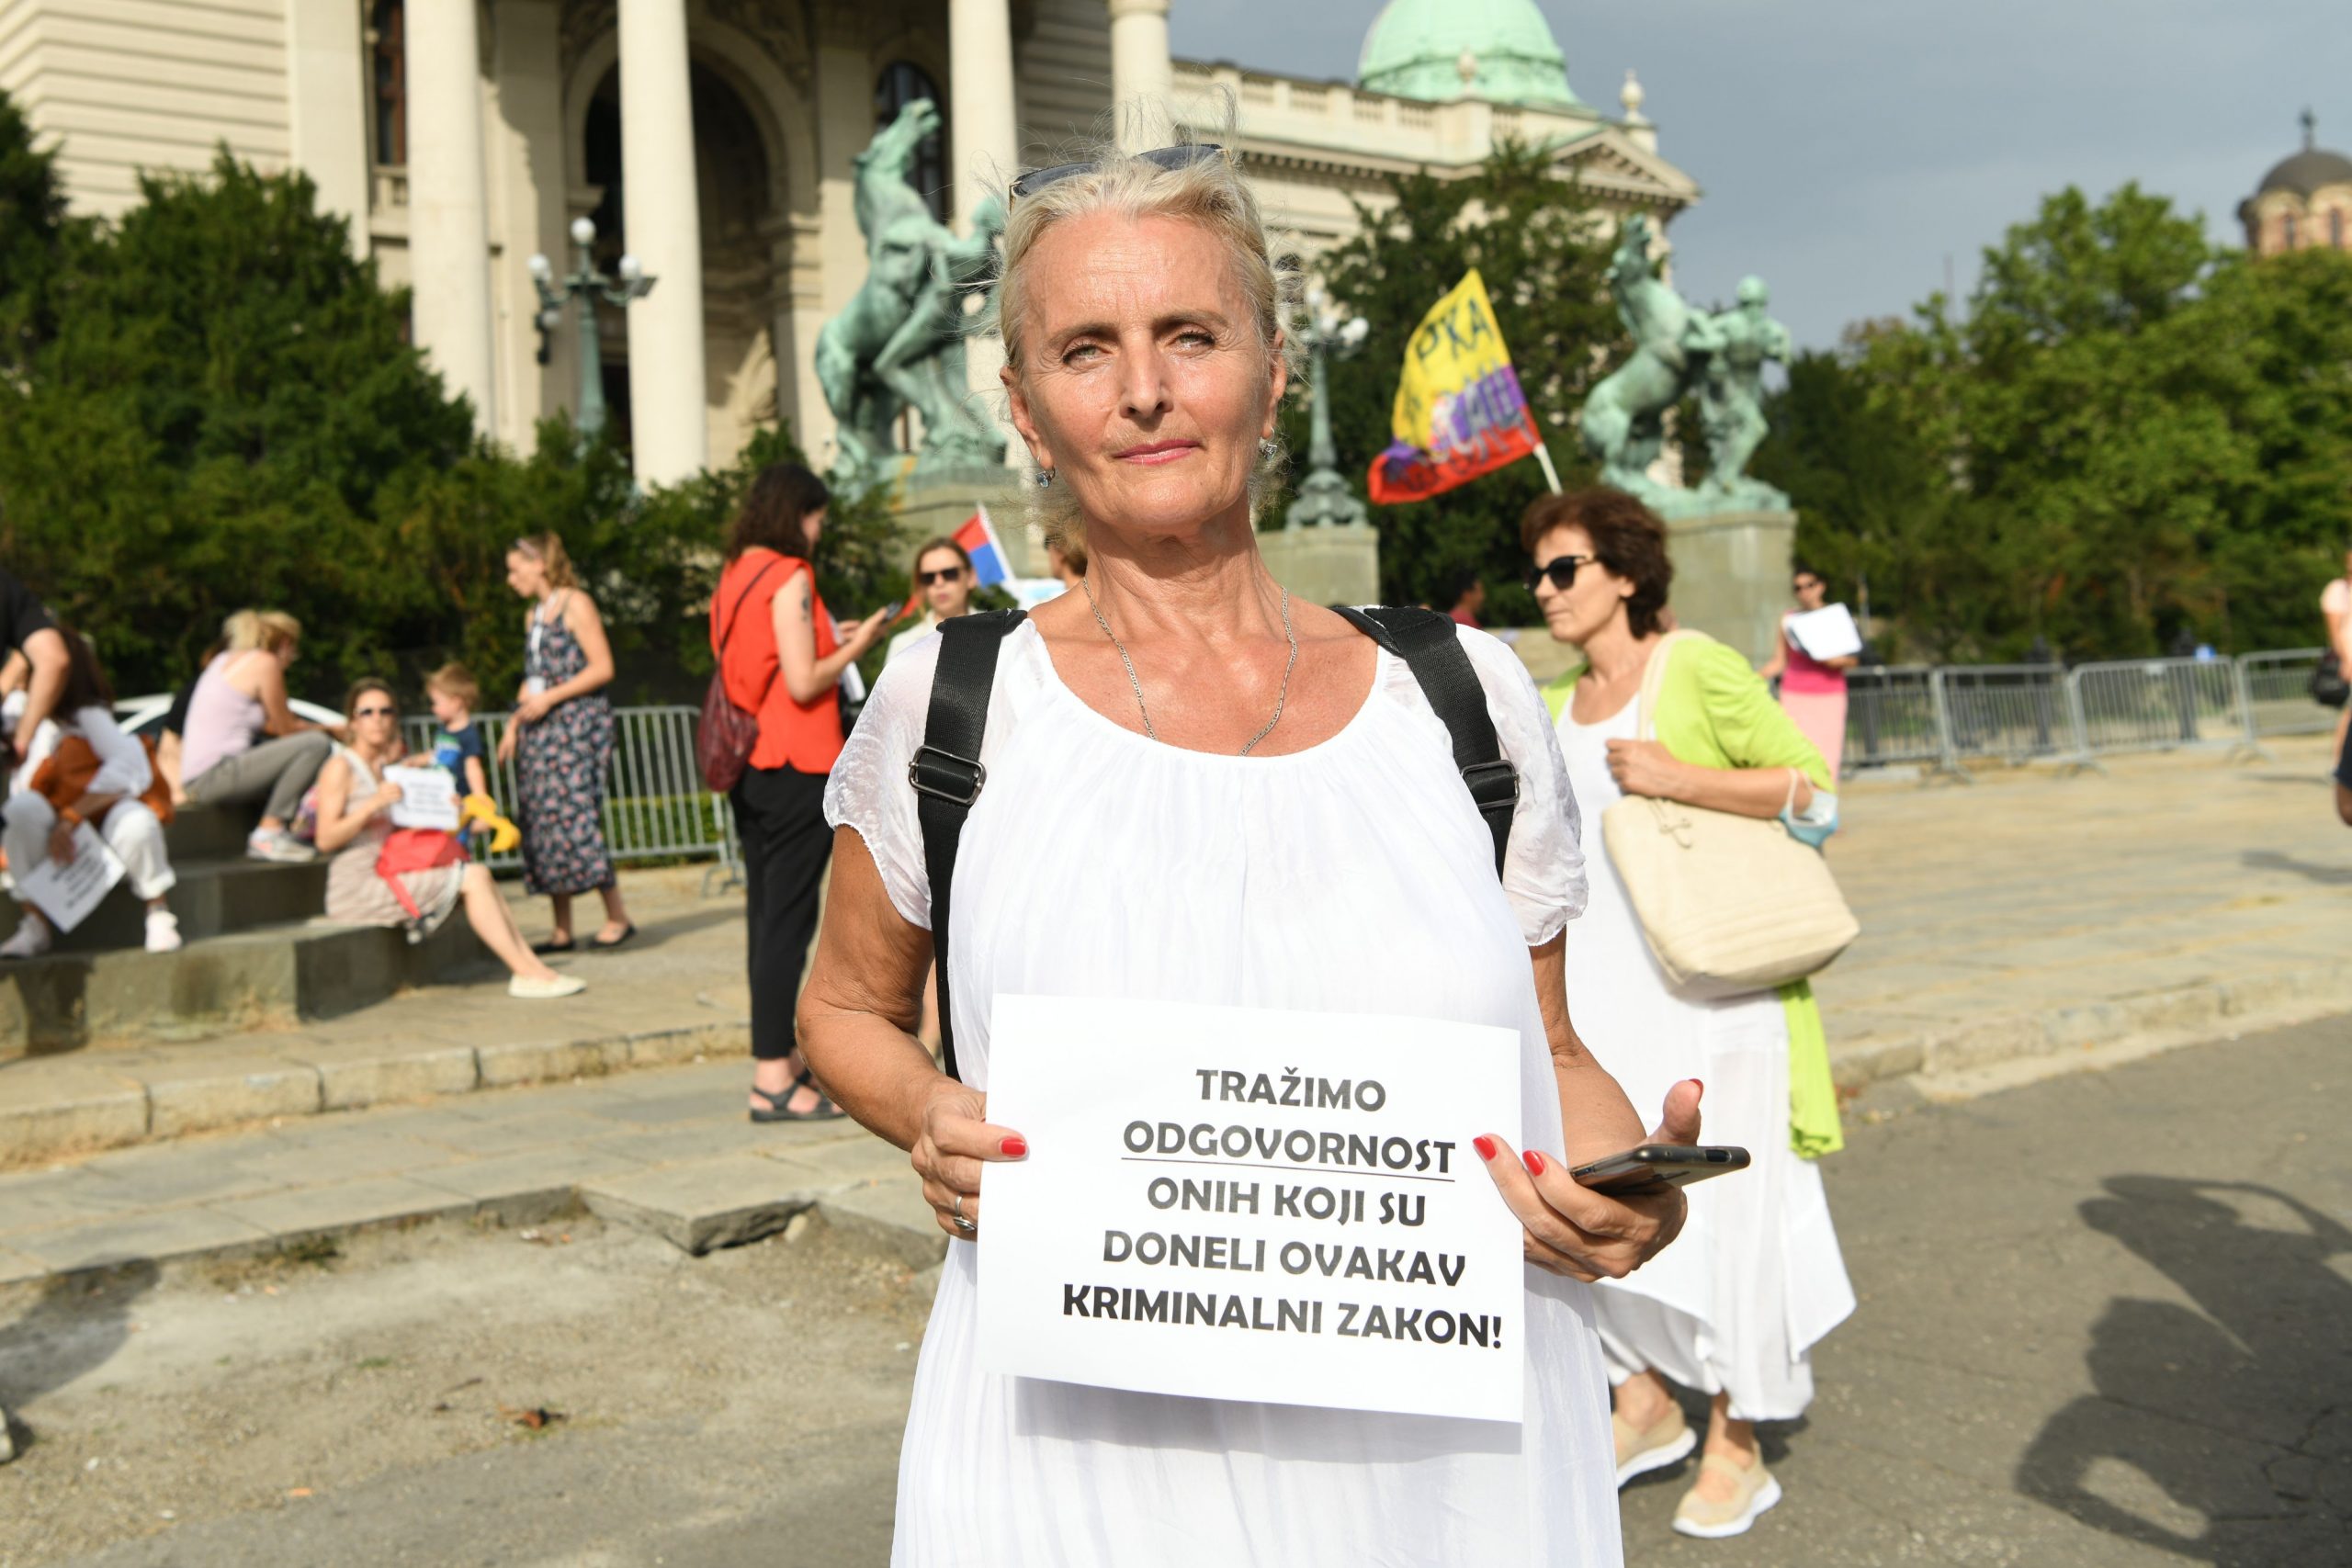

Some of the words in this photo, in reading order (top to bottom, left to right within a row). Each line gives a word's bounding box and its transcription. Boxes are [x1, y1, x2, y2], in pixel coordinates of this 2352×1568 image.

[1196, 1066, 1386, 1112] TRAŽIMO
[1123, 1120, 1456, 1174] ODGOVORNOST
[1148, 1177, 1260, 1214] ONIH
[1273, 1184, 1365, 1226] KOJI
[1378, 1191, 1426, 1227] SU
[1103, 1230, 1266, 1272] DONELI
[1279, 1241, 1465, 1287] OVAKAV
[1063, 1283, 1323, 1334] KRIMINALNI
[1337, 1303, 1503, 1349] ZAKON!
